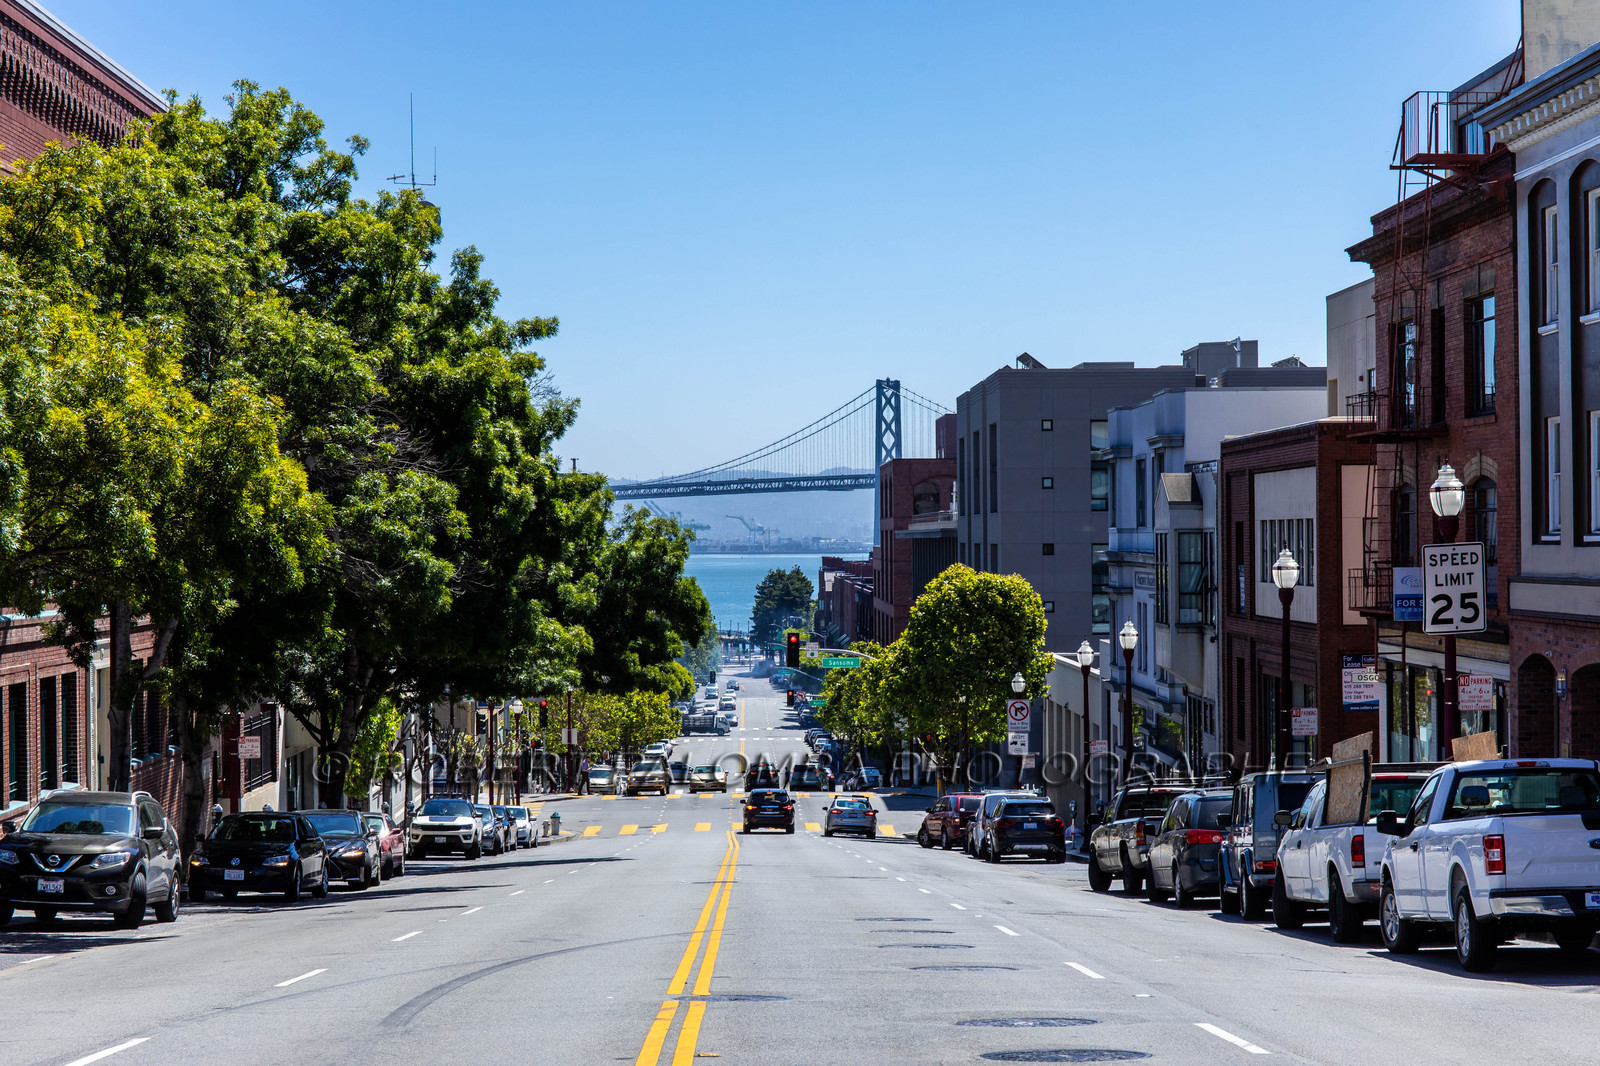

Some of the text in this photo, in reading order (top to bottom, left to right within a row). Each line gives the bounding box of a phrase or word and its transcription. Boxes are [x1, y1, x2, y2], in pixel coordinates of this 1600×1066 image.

[1429, 552, 1479, 567] SPEED
[1435, 572, 1475, 587] LIMIT
[1396, 599, 1416, 607] FOR
[1431, 592, 1480, 625] 25
[1459, 677, 1492, 686] NO PARKING
